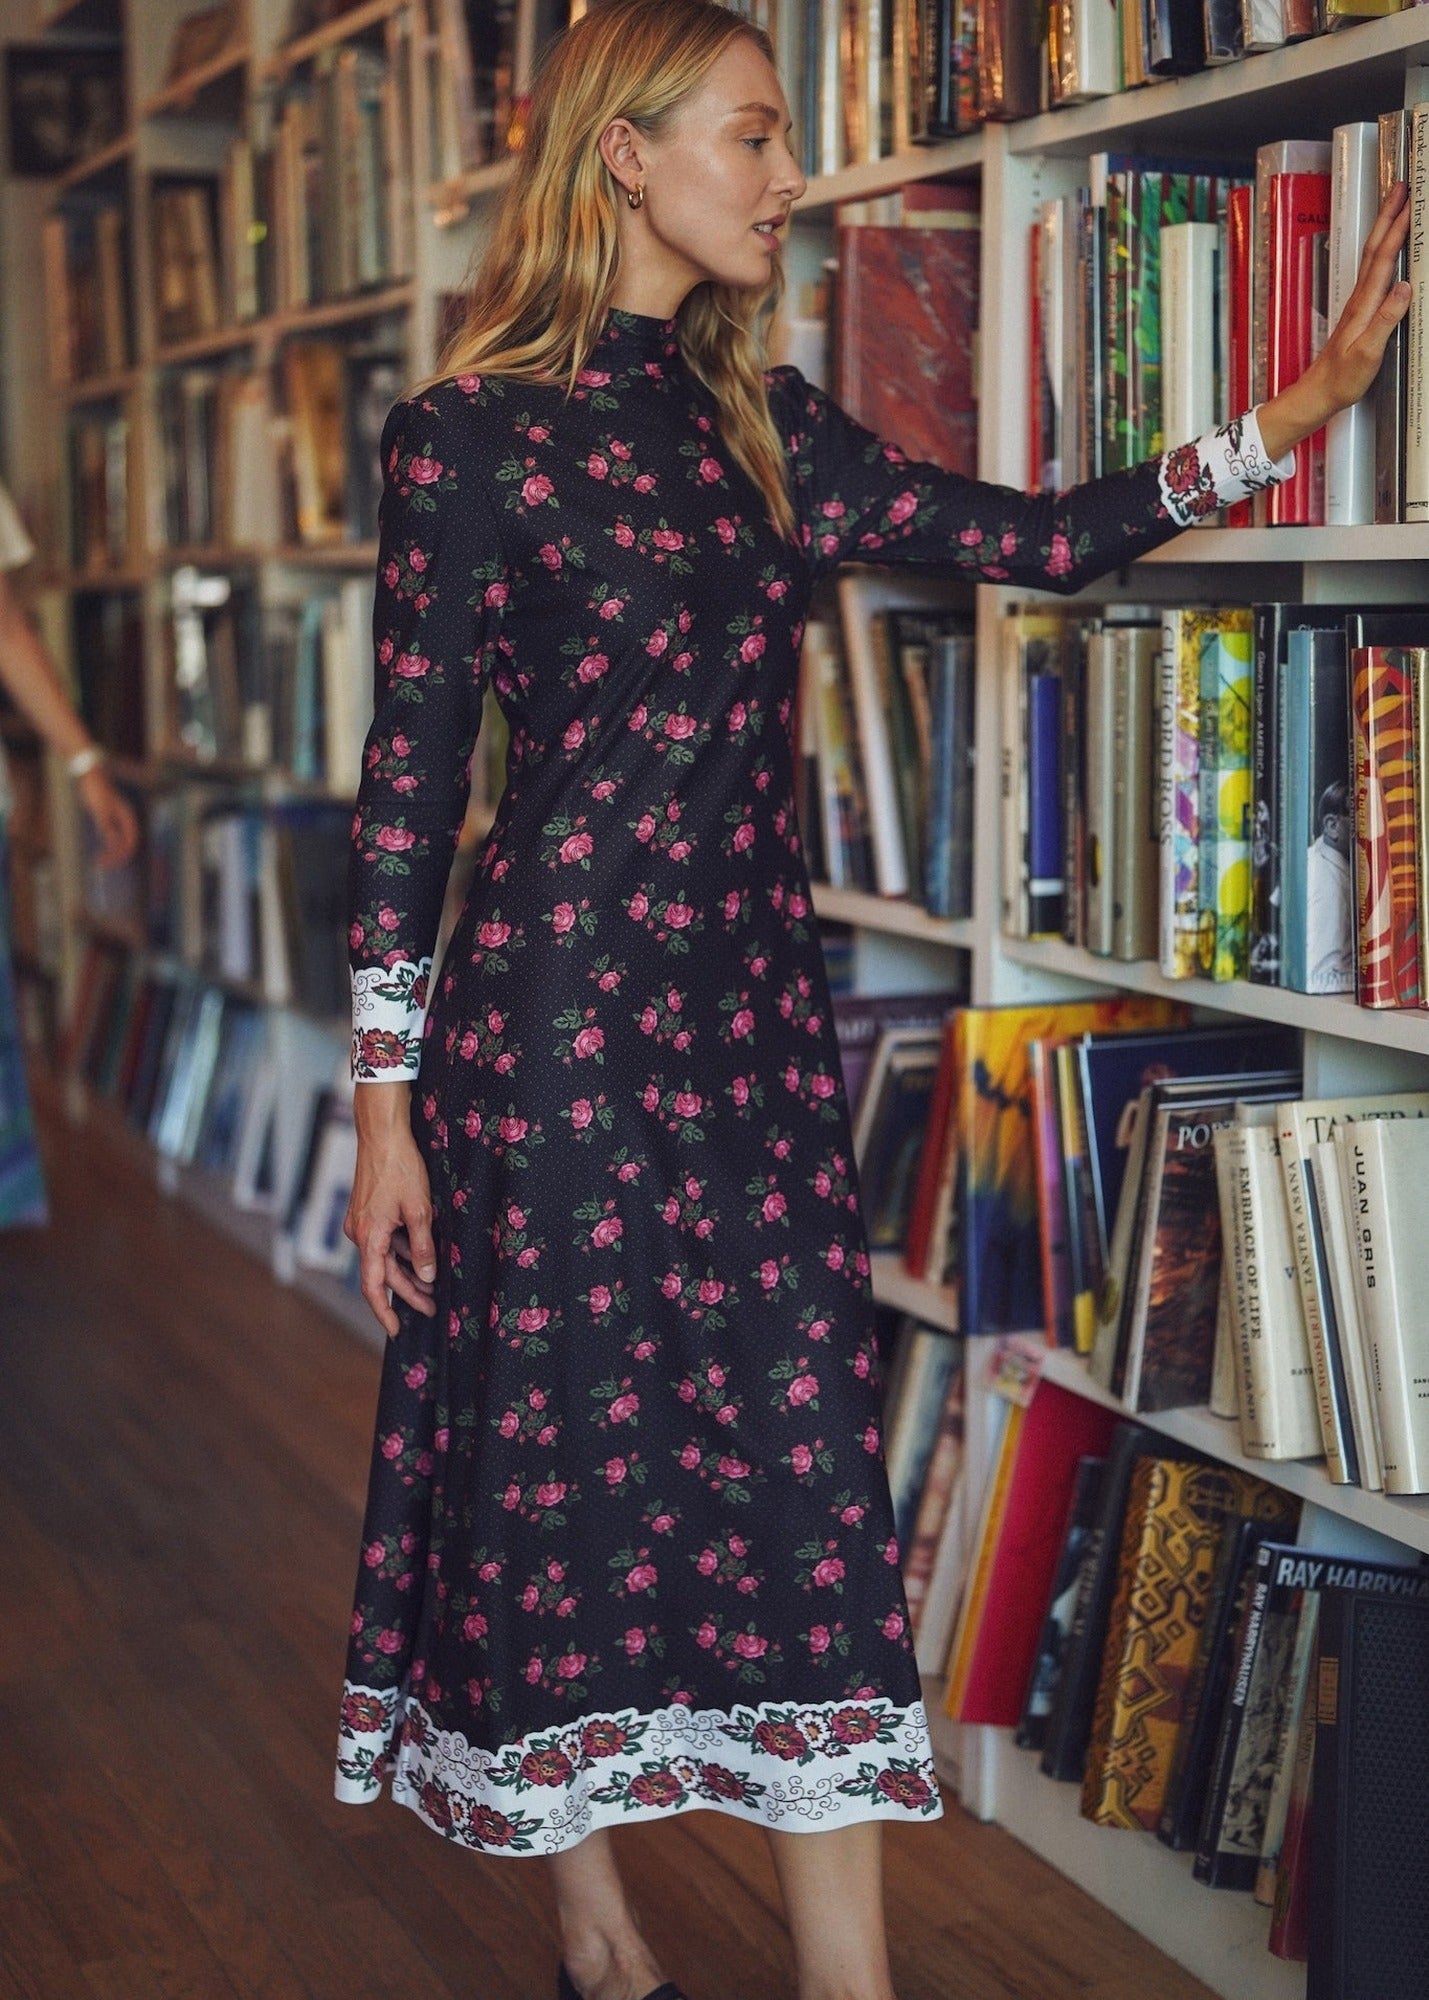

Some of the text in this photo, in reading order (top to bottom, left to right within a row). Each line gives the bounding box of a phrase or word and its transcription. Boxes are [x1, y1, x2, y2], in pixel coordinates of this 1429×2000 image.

[1413, 113, 1429, 263] People of the First Man
[1160, 626, 1176, 846] CLIFFORD ROSS
[1256, 720, 1265, 780] AMERICA
[1357, 735, 1367, 789] BARBARA
[1358, 793, 1367, 840] ROGERS
[1287, 1161, 1303, 1215] ASANA
[1354, 1145, 1377, 1288] JUAN GRIS
[1239, 1167, 1261, 1339] EMBRACE OF LIFE
[1296, 1223, 1313, 1285] TANTRA
[1319, 1394, 1332, 1427] AJIT
[1252, 1582, 1269, 1610] RAY
[1276, 1557, 1324, 1590] RAY
